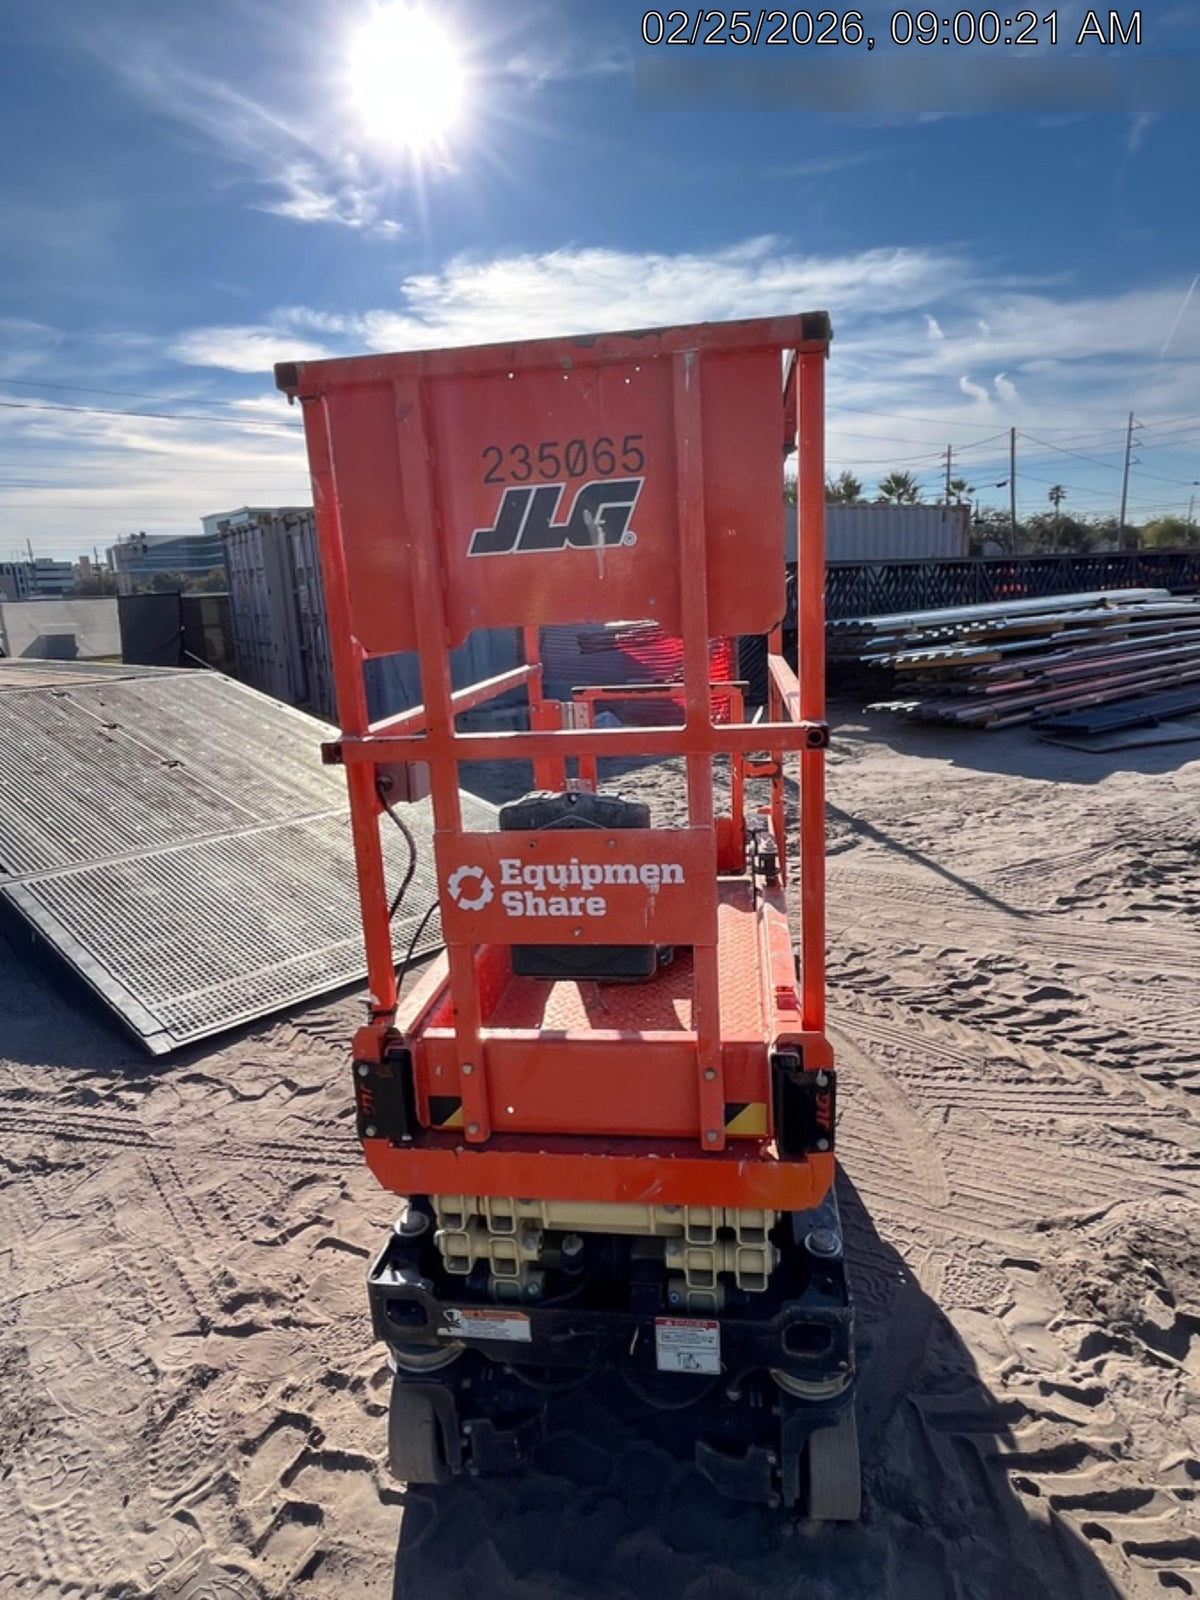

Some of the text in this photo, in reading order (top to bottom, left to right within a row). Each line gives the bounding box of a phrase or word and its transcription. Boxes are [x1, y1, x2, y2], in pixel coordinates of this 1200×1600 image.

[482, 434, 645, 484] 235065
[466, 476, 646, 557] JLG
[500, 858, 685, 891] Equipmen
[501, 891, 607, 916] Share
